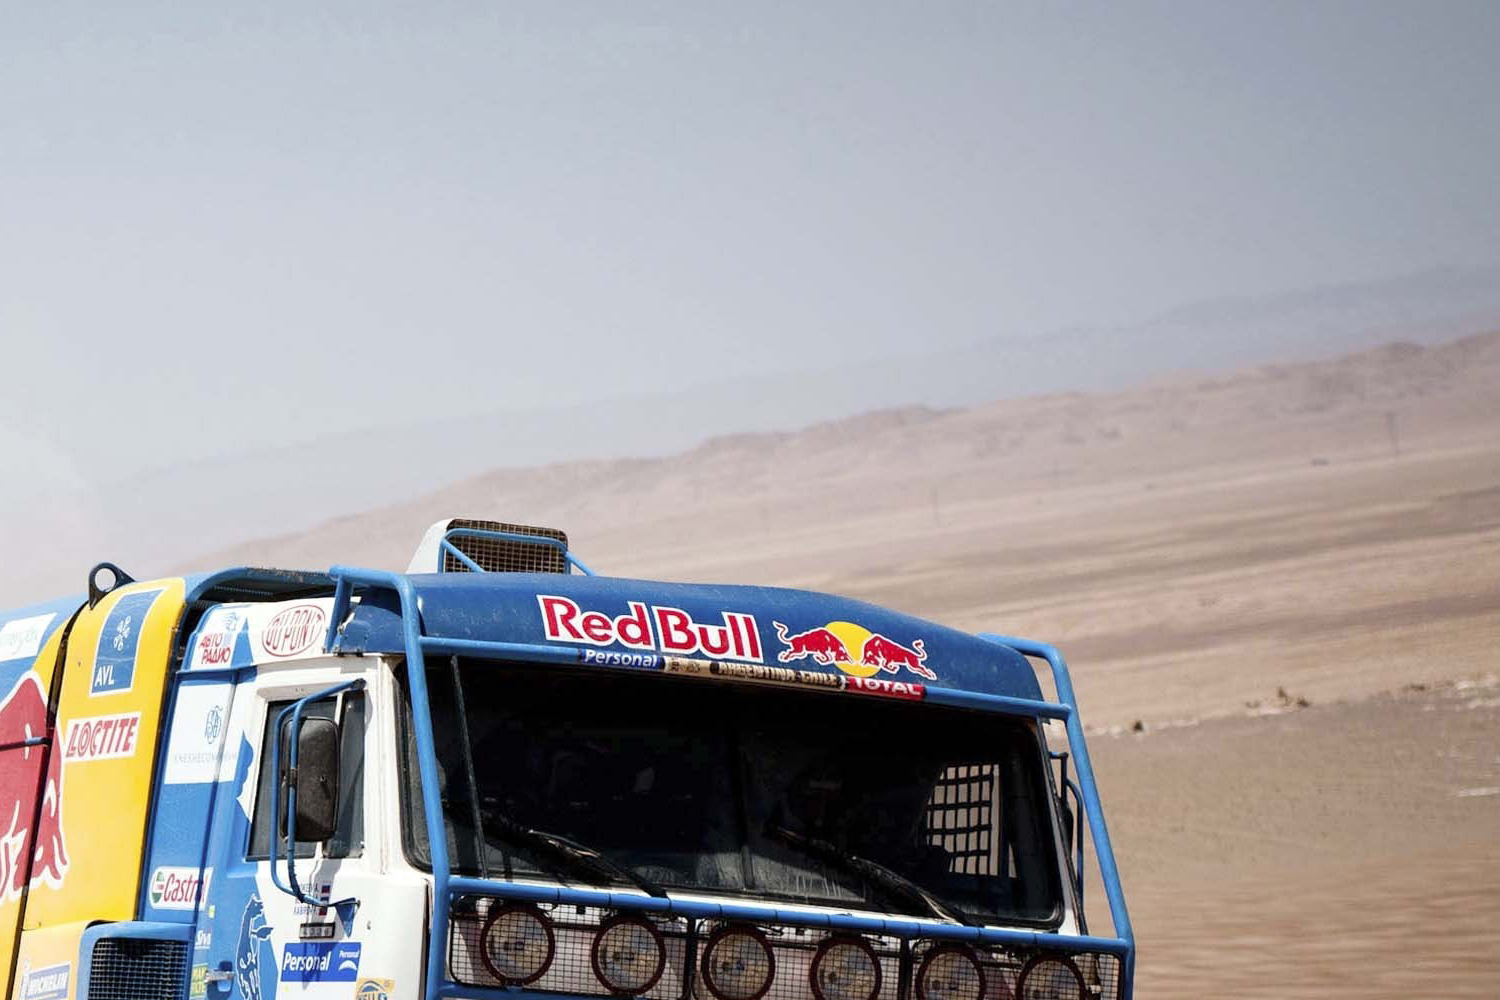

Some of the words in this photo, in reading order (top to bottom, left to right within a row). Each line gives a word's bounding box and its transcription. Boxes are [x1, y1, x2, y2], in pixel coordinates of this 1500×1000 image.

[538, 596, 654, 650] Red
[653, 607, 763, 662] Bull
[584, 650, 658, 668] Personal
[94, 664, 115, 687] AVL
[855, 677, 921, 696] TOTAL
[65, 716, 139, 759] LOCTITE
[282, 951, 332, 972] Personal
